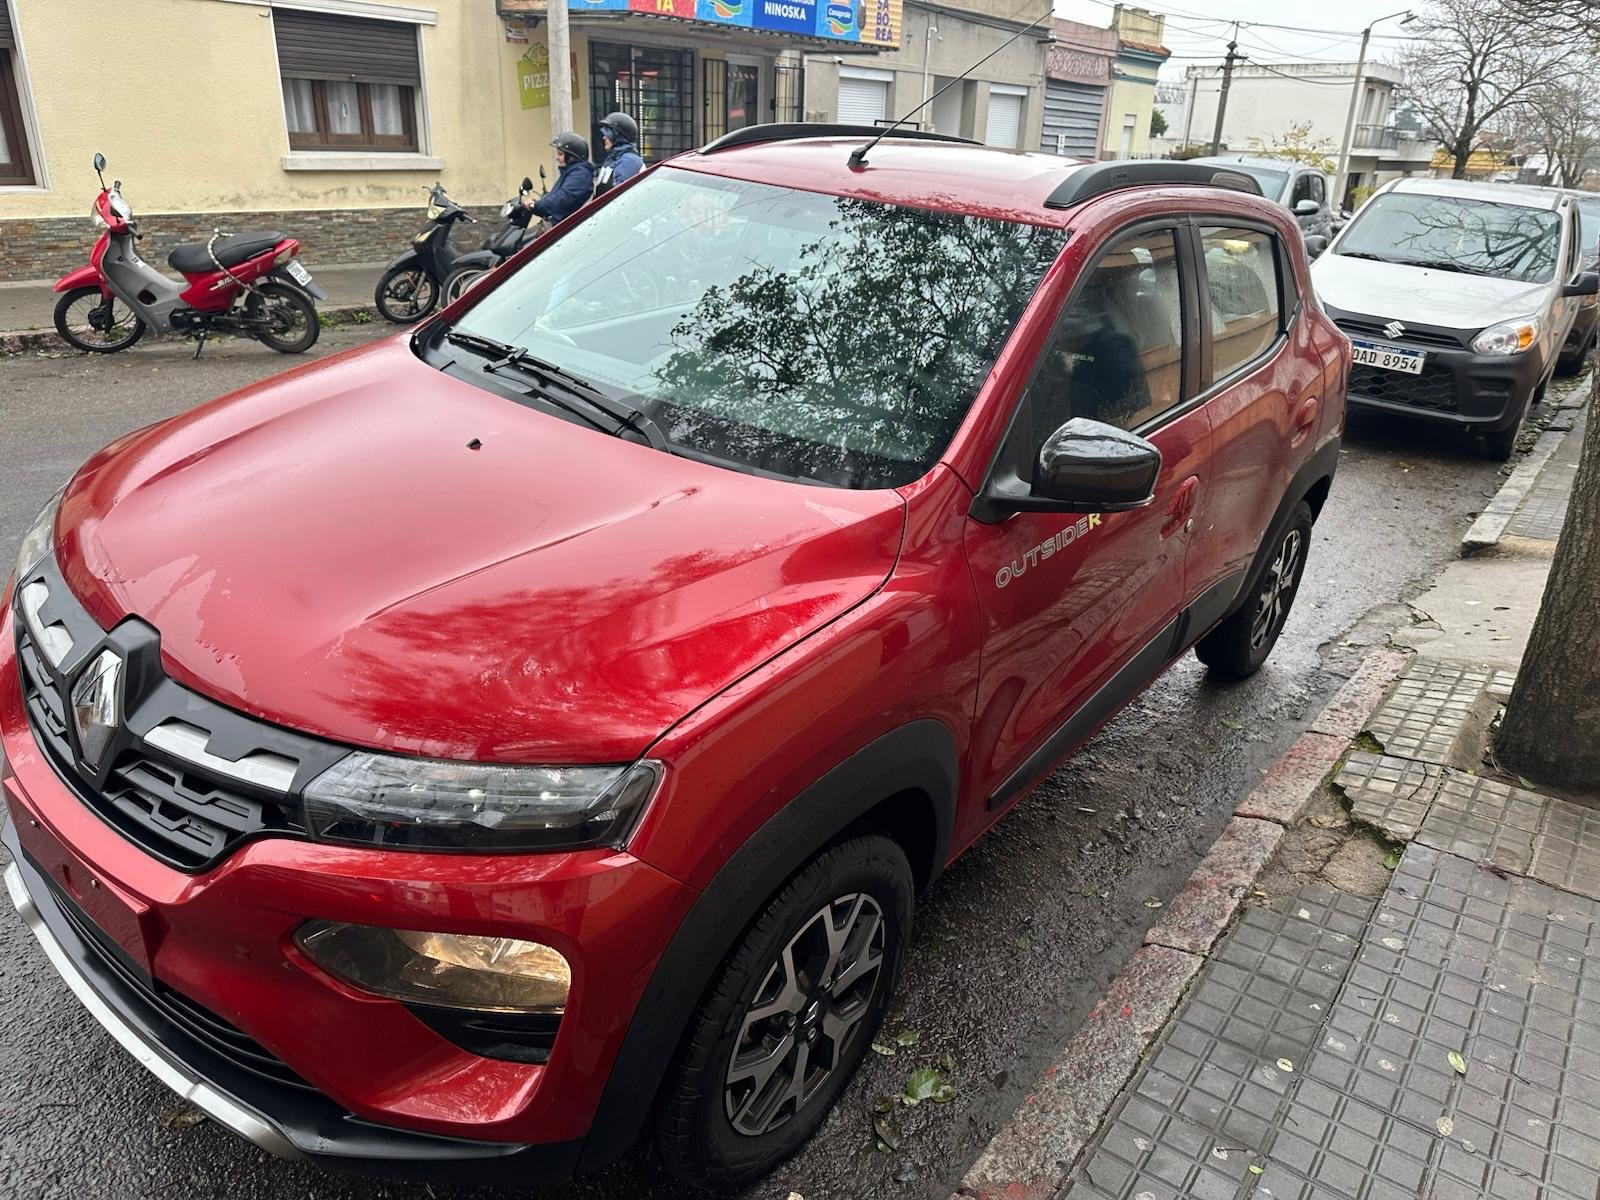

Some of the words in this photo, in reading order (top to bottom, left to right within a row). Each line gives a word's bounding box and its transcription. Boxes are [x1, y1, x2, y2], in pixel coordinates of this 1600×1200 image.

[764, 1, 807, 21] NINOSKA
[1383, 354, 1418, 371] 8954
[995, 512, 1102, 588] OUTSIDER
